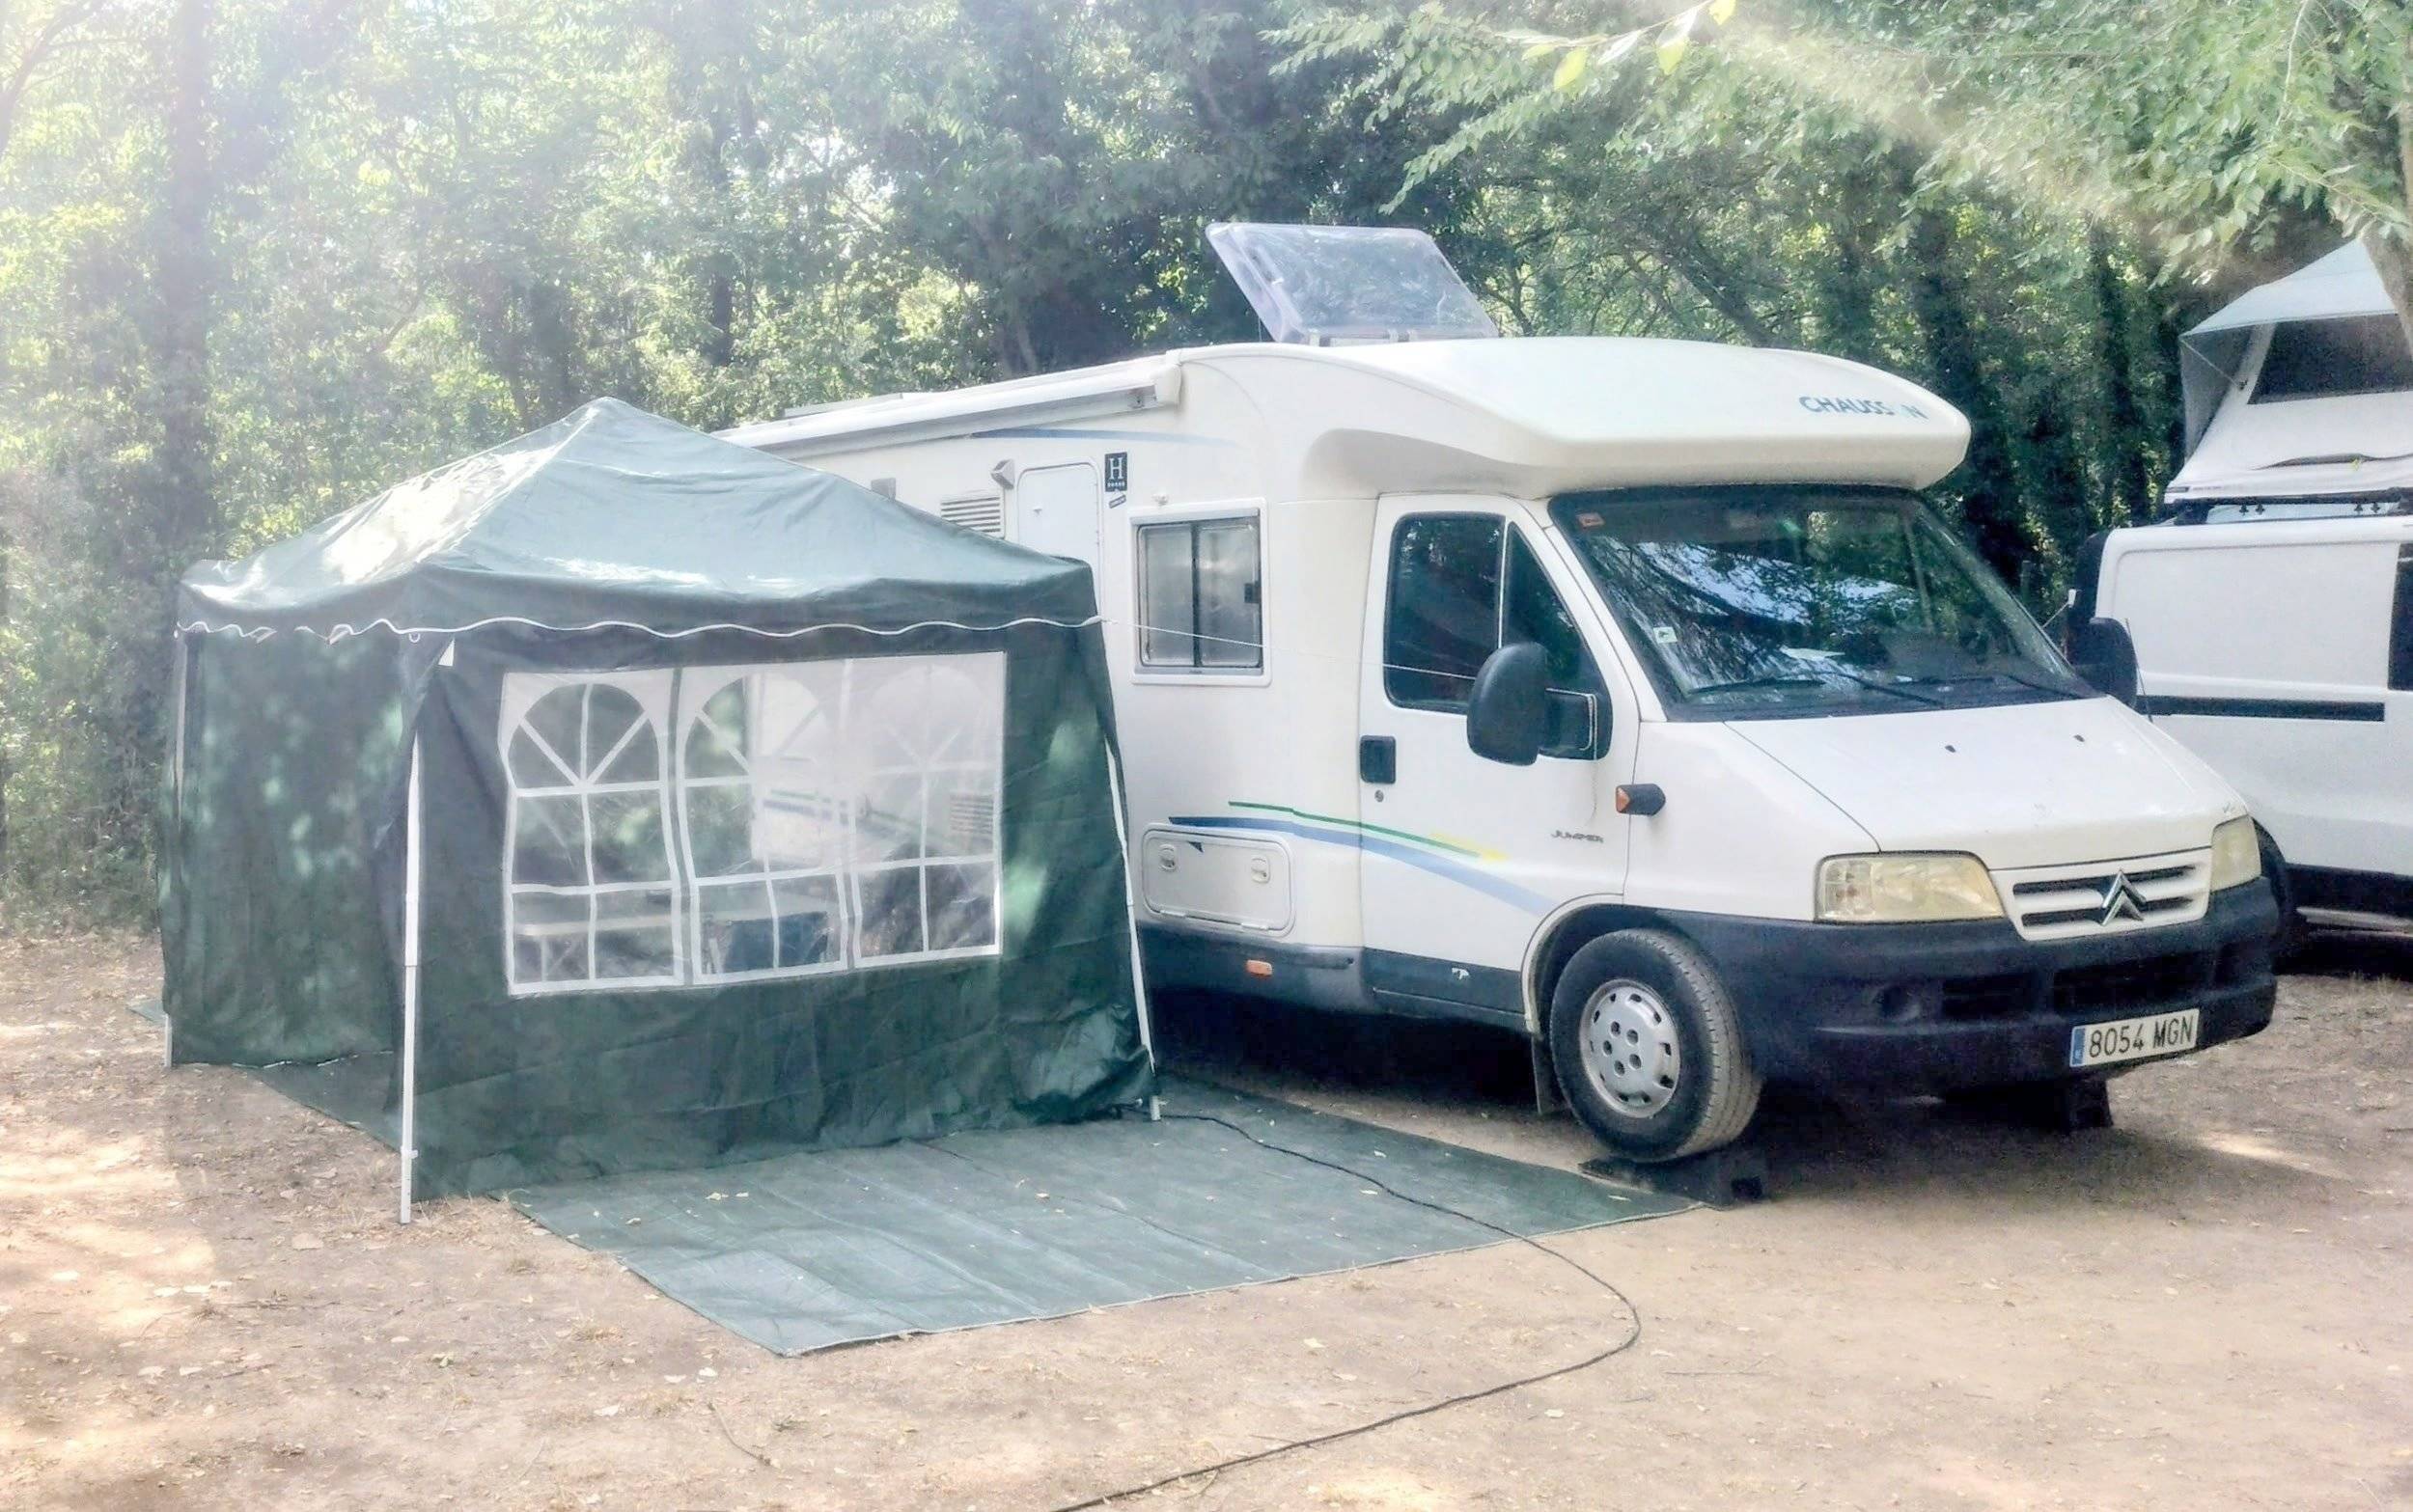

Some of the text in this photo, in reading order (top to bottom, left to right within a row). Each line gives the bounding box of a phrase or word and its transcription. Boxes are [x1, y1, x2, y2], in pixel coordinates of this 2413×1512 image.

[1798, 396, 1929, 420] CHAUSSN
[1109, 456, 1123, 480] H
[2089, 1015, 2193, 1058] 8054 MGN
